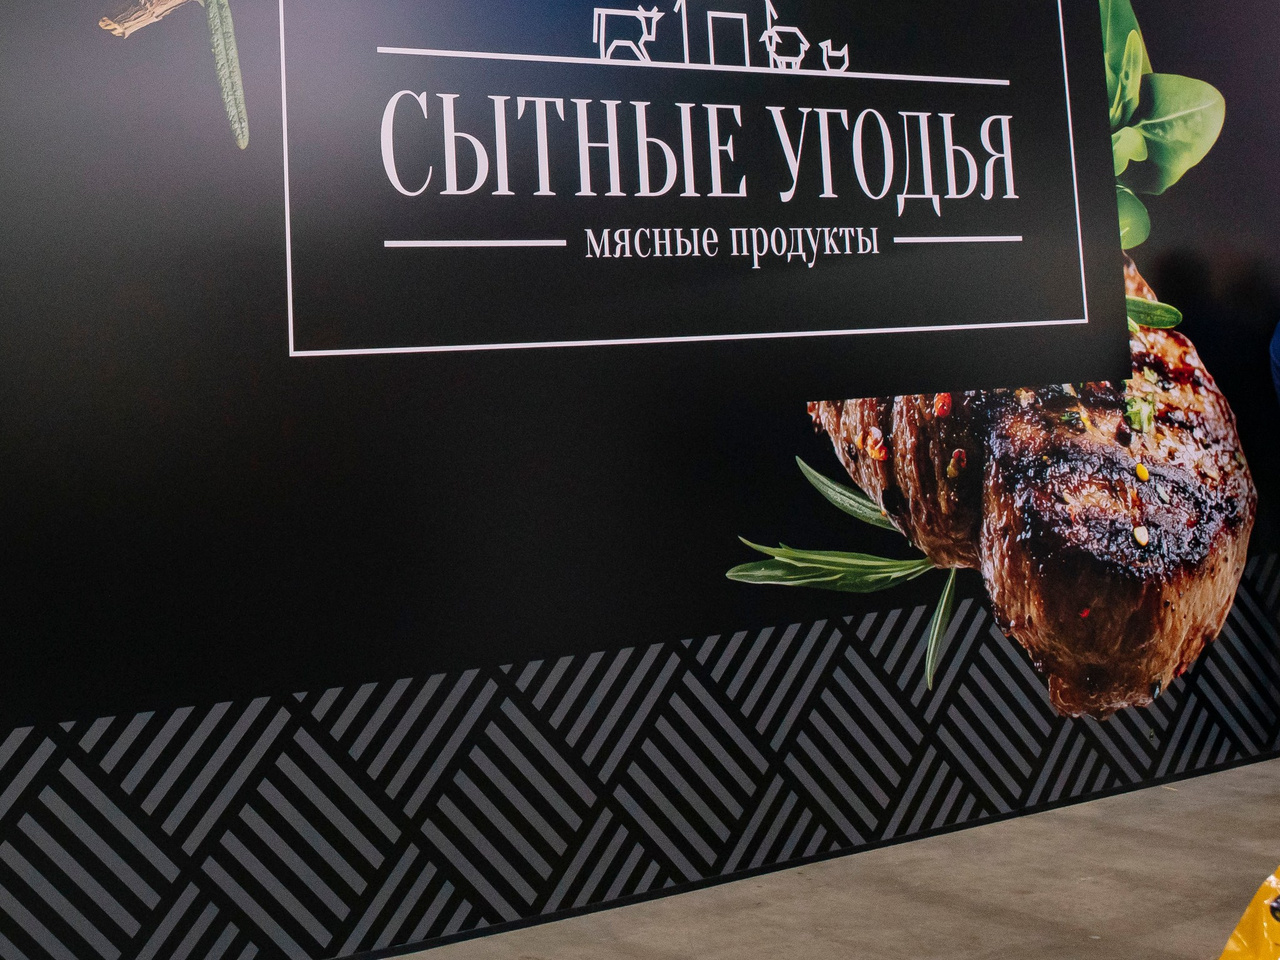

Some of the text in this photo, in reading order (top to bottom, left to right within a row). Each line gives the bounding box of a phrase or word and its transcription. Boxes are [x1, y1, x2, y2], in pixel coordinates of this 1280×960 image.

[379, 88, 1021, 218] СЫТНЫЕ УГОДЬЯ
[583, 226, 880, 269] мясные продукты
